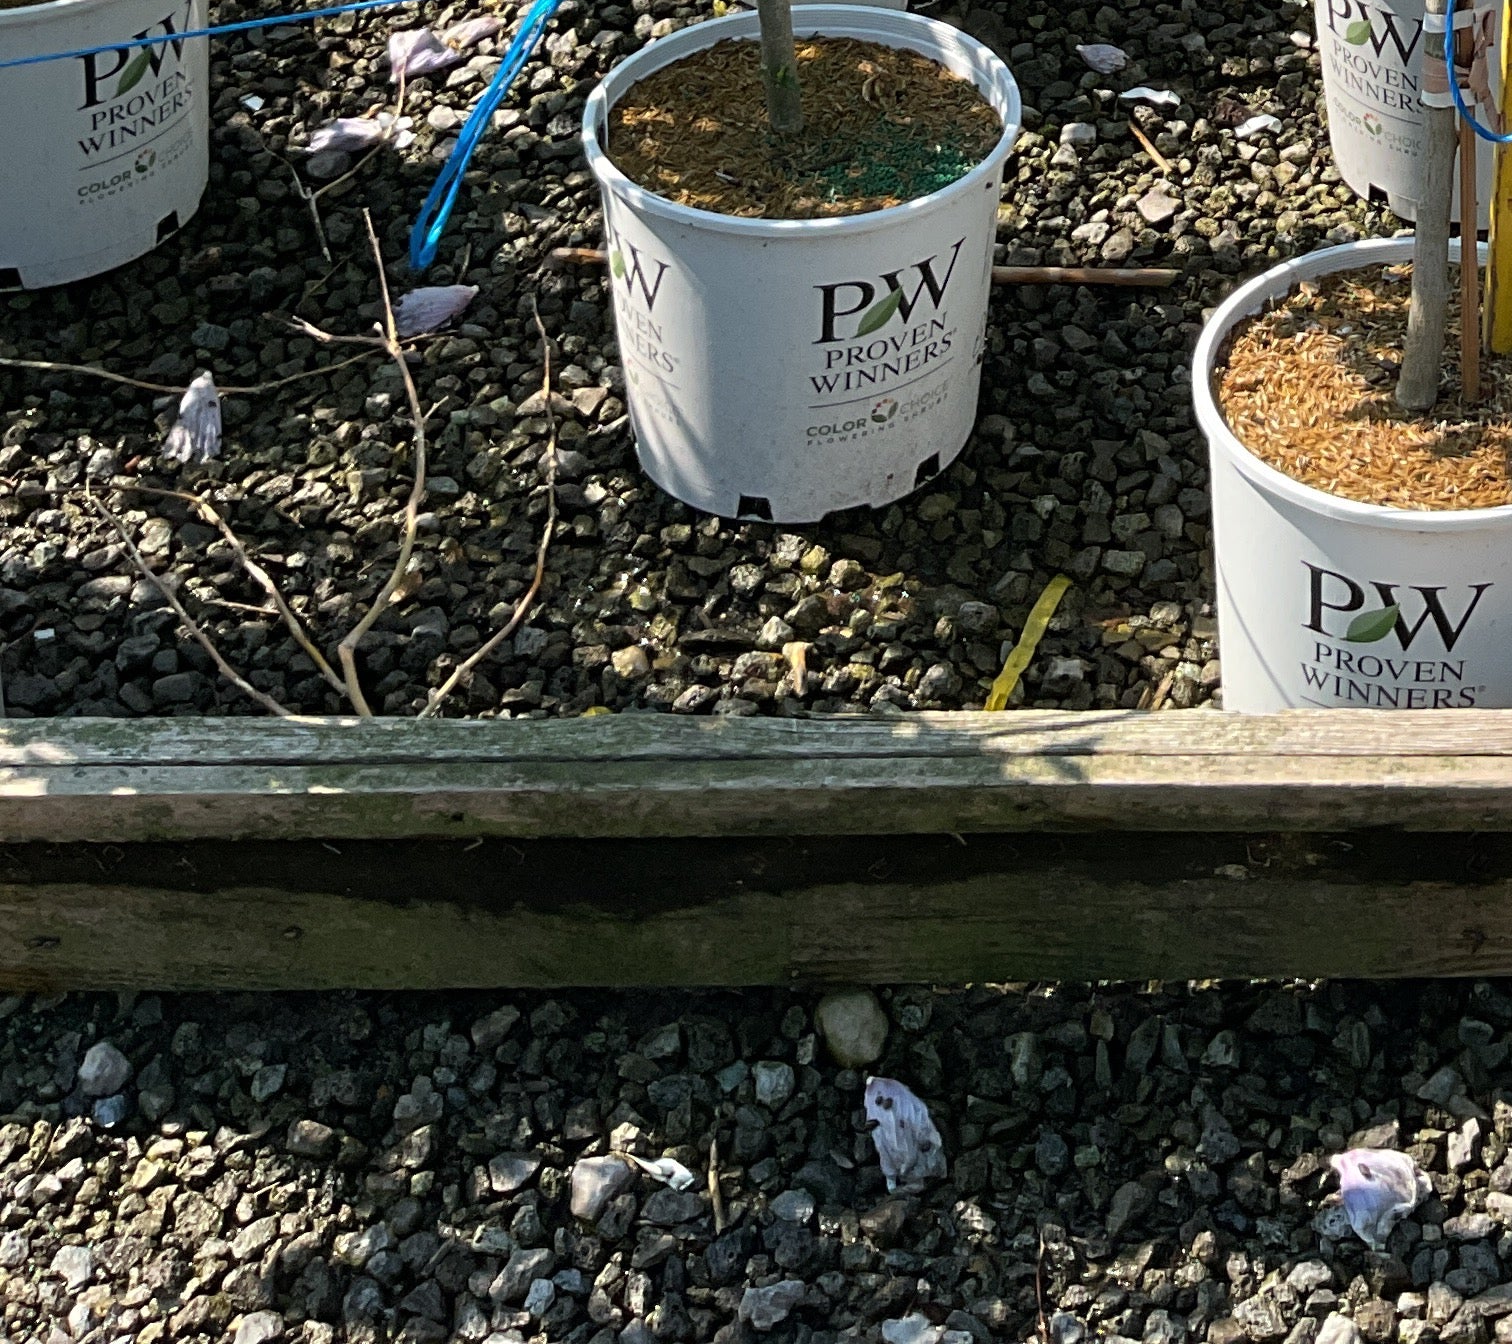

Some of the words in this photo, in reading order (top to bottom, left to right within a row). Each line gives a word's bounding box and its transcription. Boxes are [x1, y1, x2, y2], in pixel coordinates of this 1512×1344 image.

[1333, 41, 1418, 92] PROVEN
[78, 85, 192, 156] WINNERS
[91, 71, 187, 131] PROVEN
[78, 170, 132, 197] COLOR
[811, 238, 966, 345] PW
[808, 337, 953, 394] WINNERS
[824, 312, 947, 370] PROVEN
[806, 417, 867, 438] COLOR
[1301, 560, 1494, 652] PW
[1301, 662, 1477, 709] WINNERS
[1314, 641, 1467, 683] PROVEN
